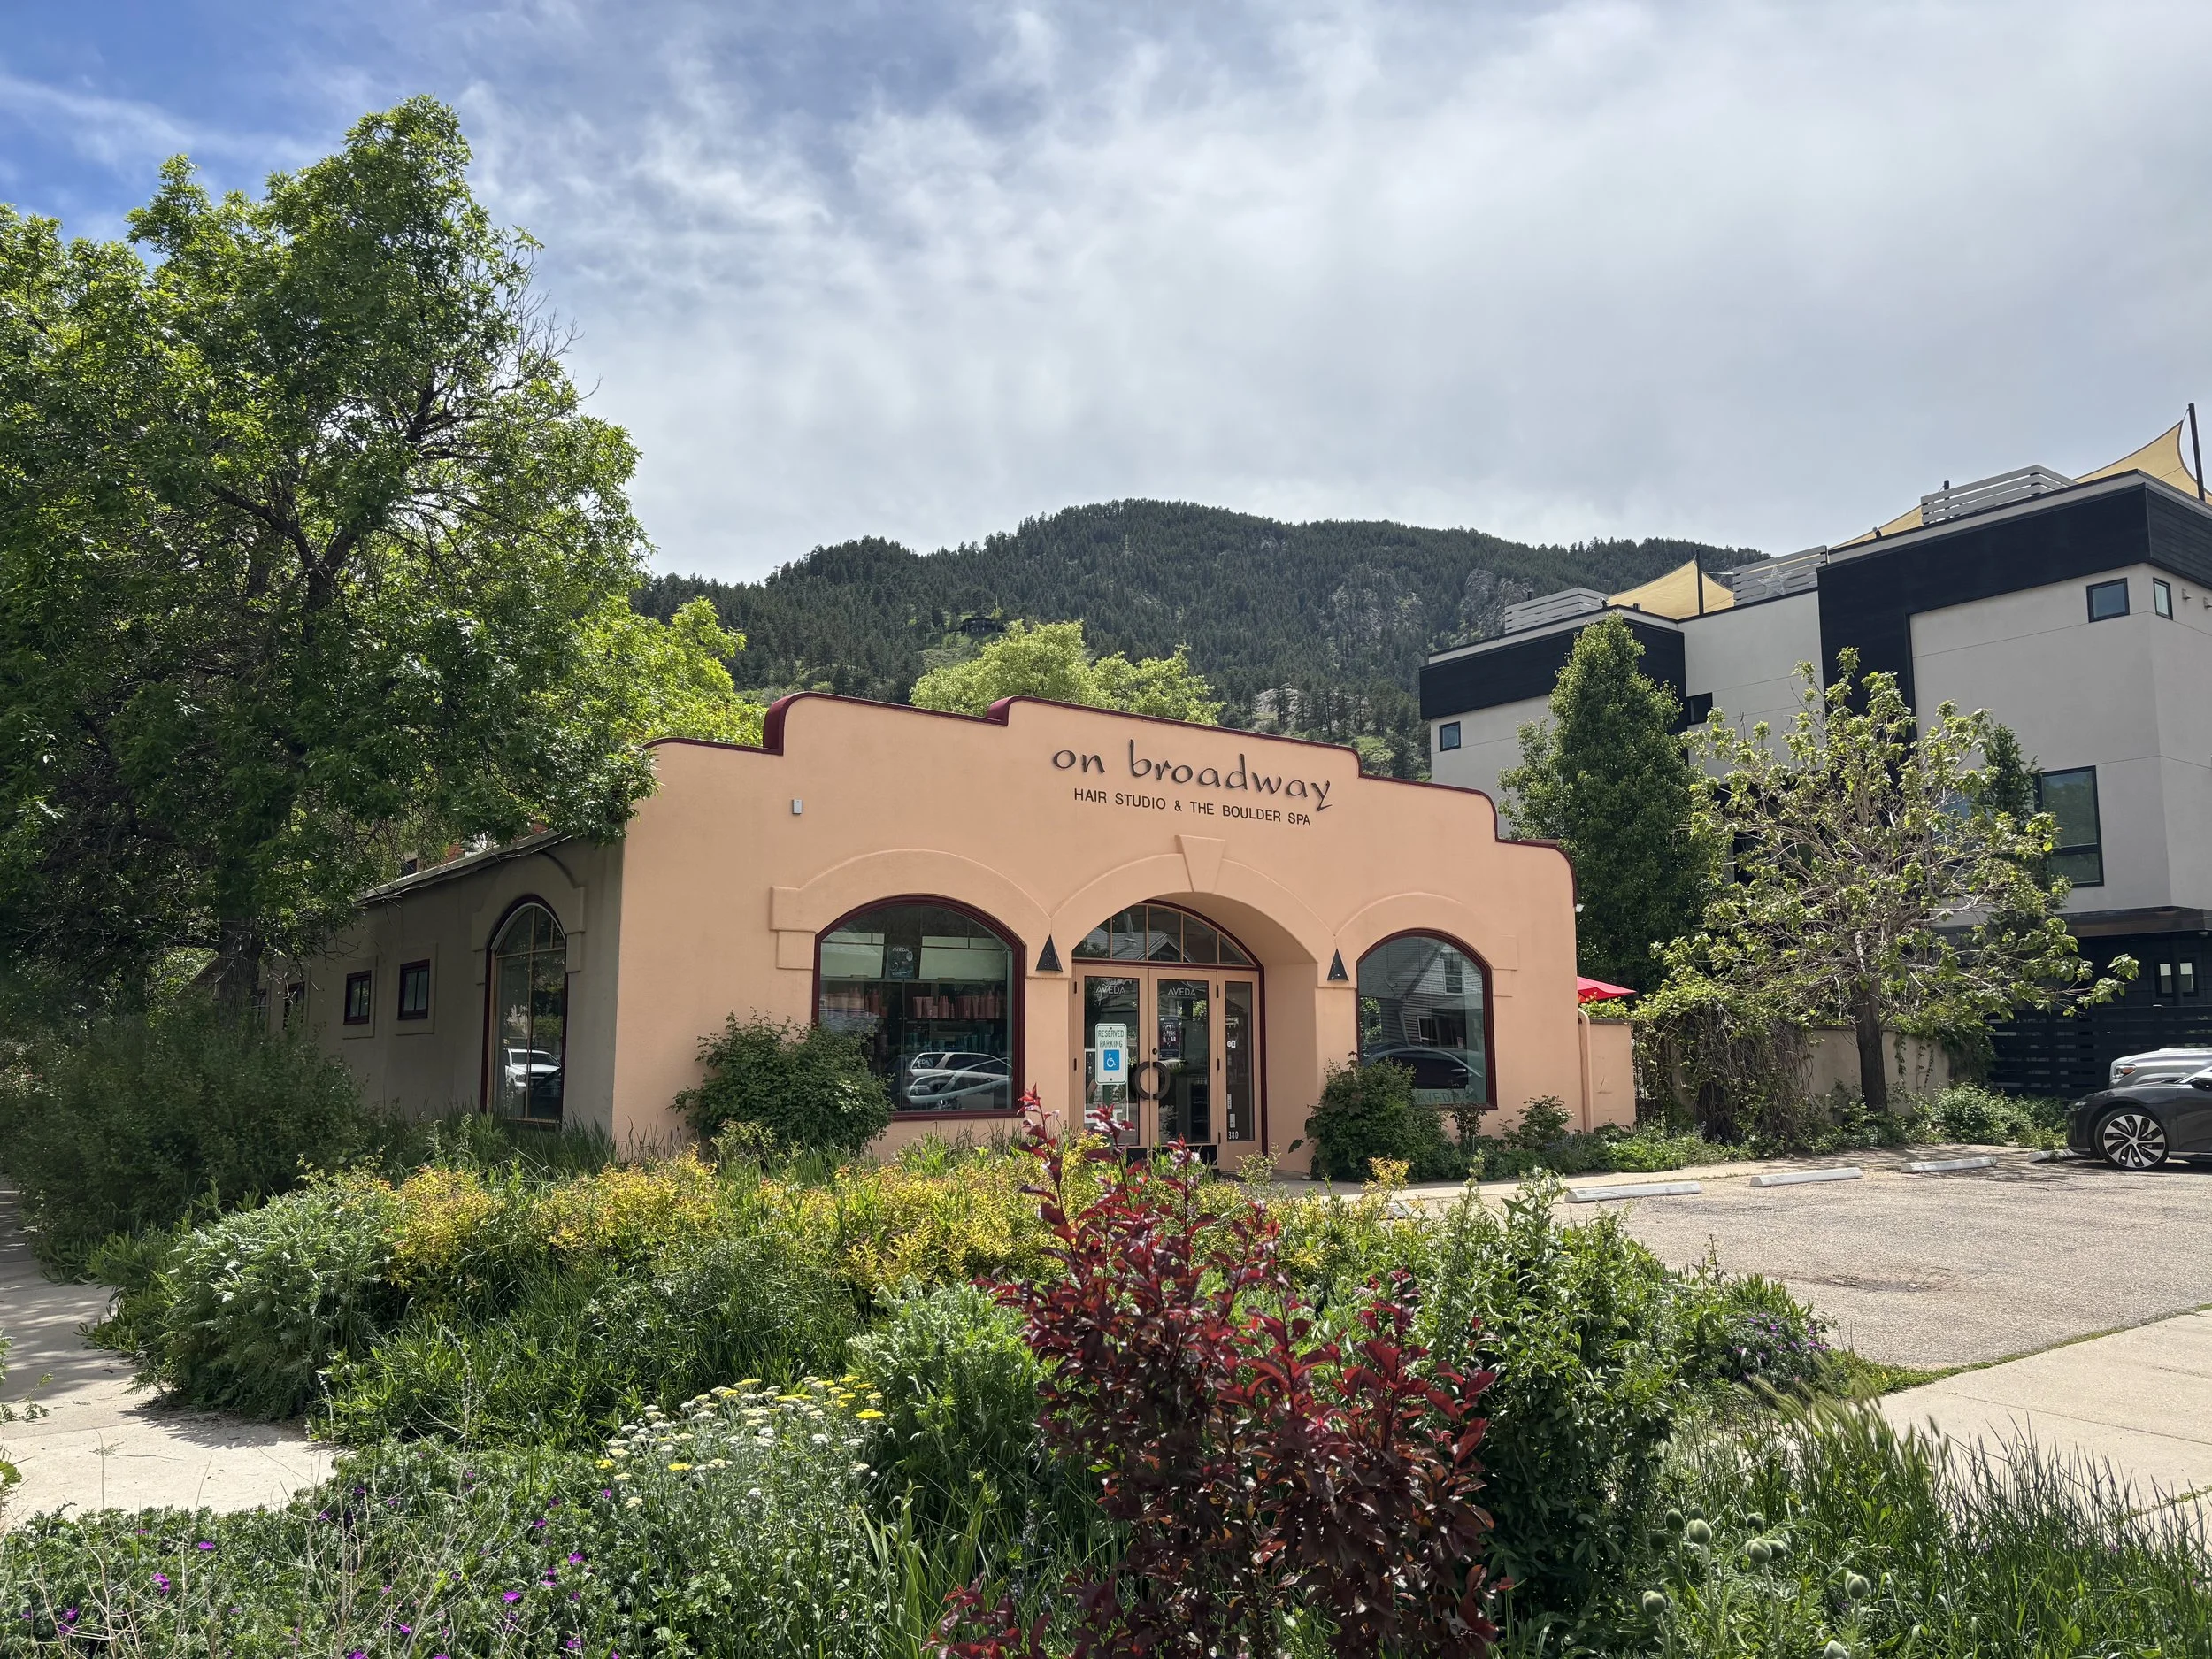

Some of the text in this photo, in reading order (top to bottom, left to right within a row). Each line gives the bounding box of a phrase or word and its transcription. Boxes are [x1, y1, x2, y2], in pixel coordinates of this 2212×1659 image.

[1051, 738, 1333, 811] on broadway
[1074, 788, 1310, 826] HAIR STUDIO & THE BOULDER SPA
[1095, 985, 1125, 995] AVEDA
[1167, 987, 1196, 996] AVEDA
[1228, 1131, 1239, 1140] 380
